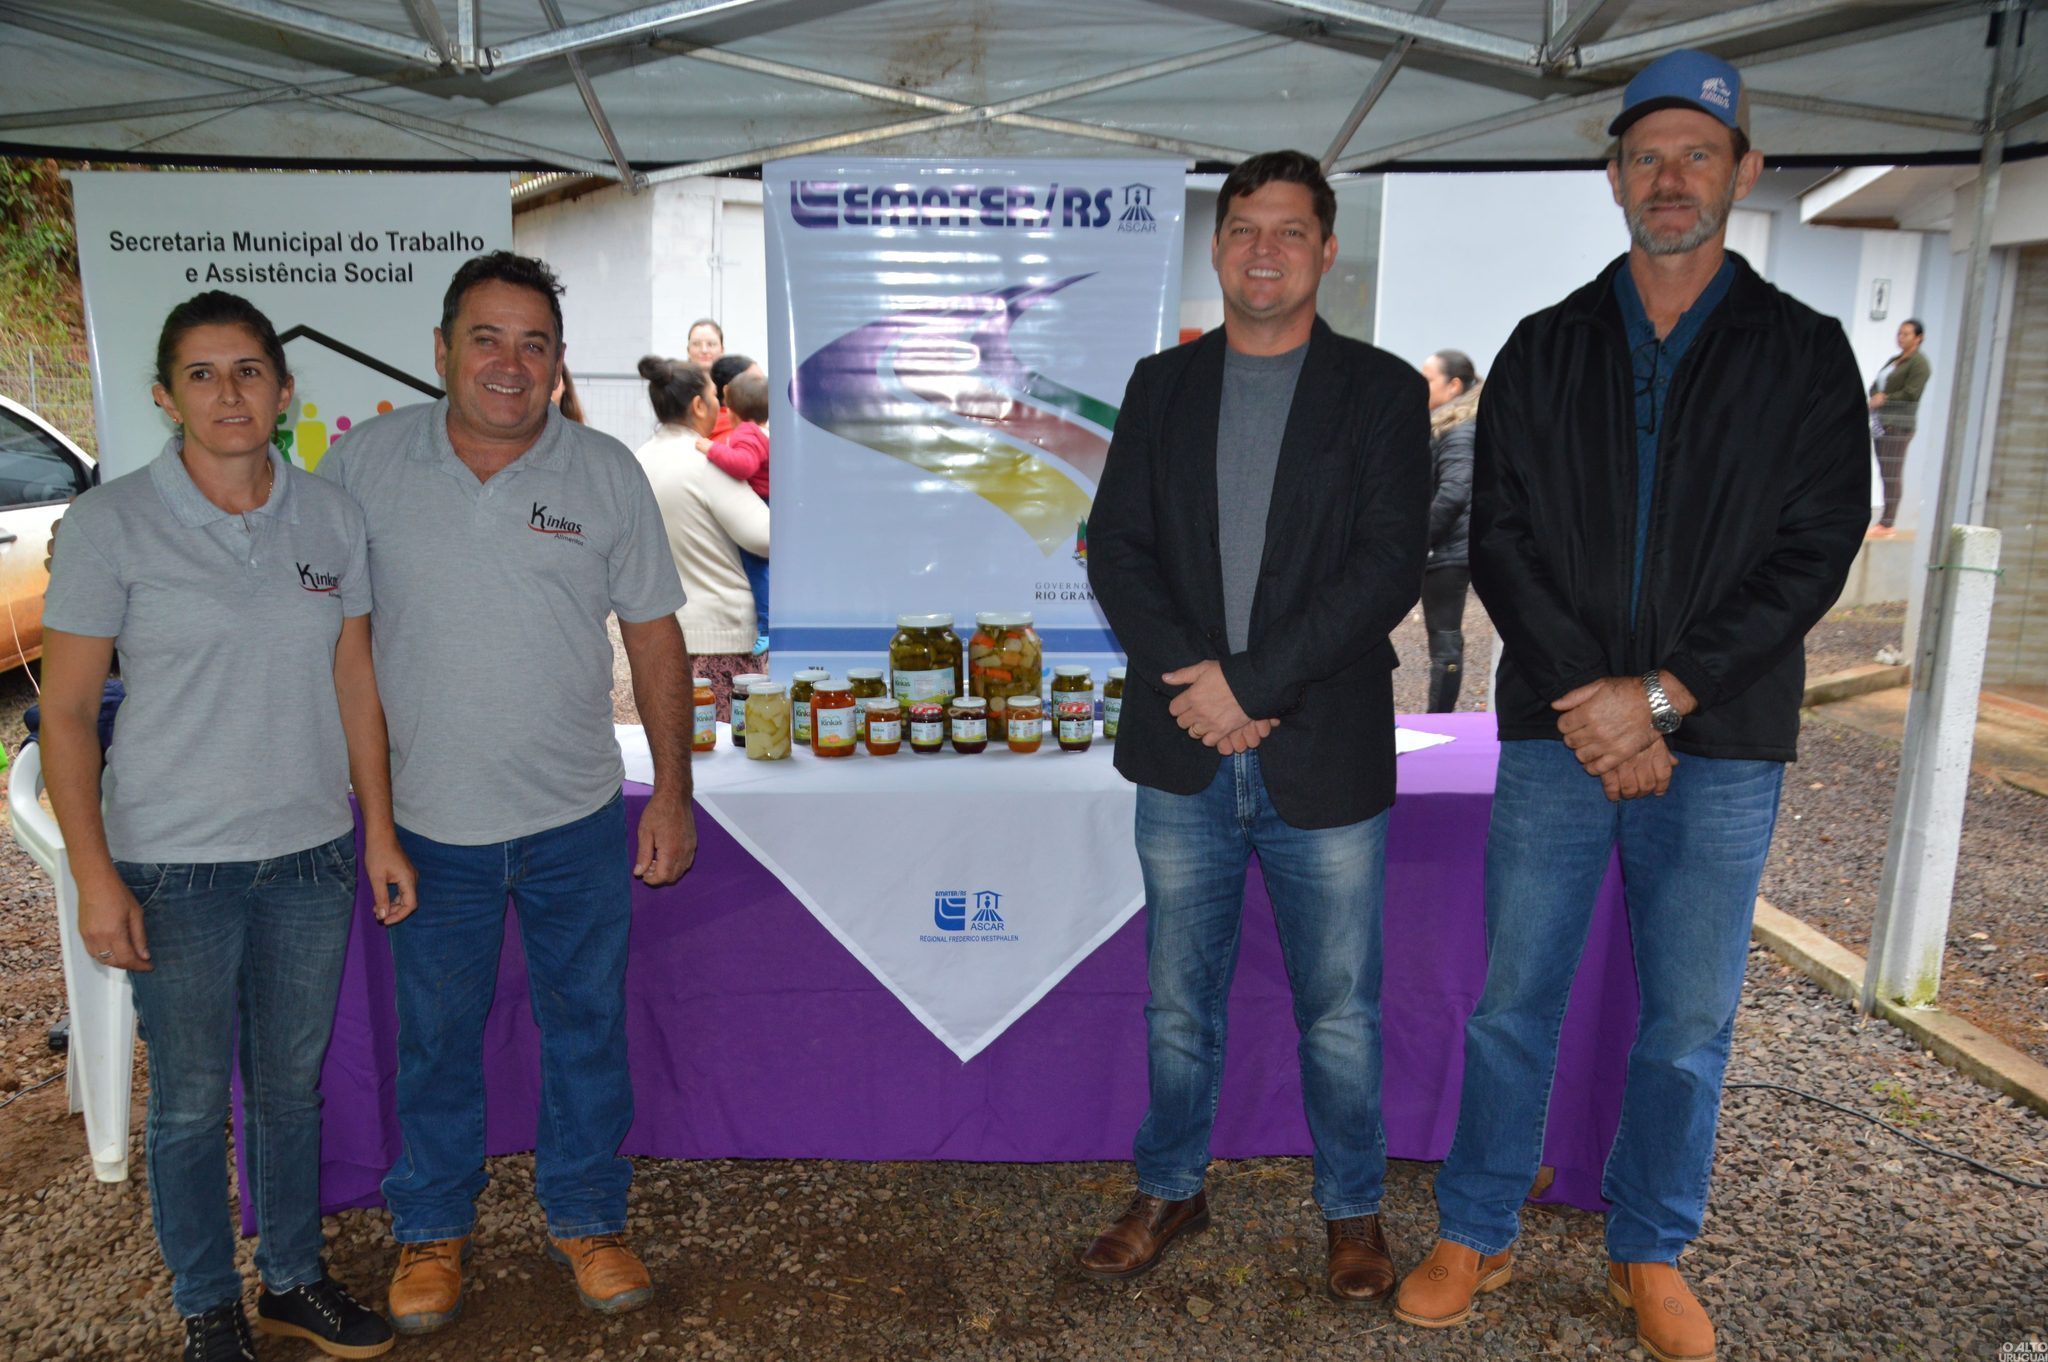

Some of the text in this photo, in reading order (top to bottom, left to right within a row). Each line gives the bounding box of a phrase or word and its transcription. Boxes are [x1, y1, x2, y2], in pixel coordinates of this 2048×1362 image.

[1116, 223, 1157, 232] ASCAR
[109, 229, 485, 257] Secretaria Municipal do Trabalho
[185, 262, 413, 284] e Assistência Social
[530, 502, 583, 533] Kinkas
[296, 562, 338, 589] Kinka
[1035, 582, 1089, 590] GOVERNO
[1035, 591, 1056, 600] RIO
[970, 922, 1004, 931] ASCAR
